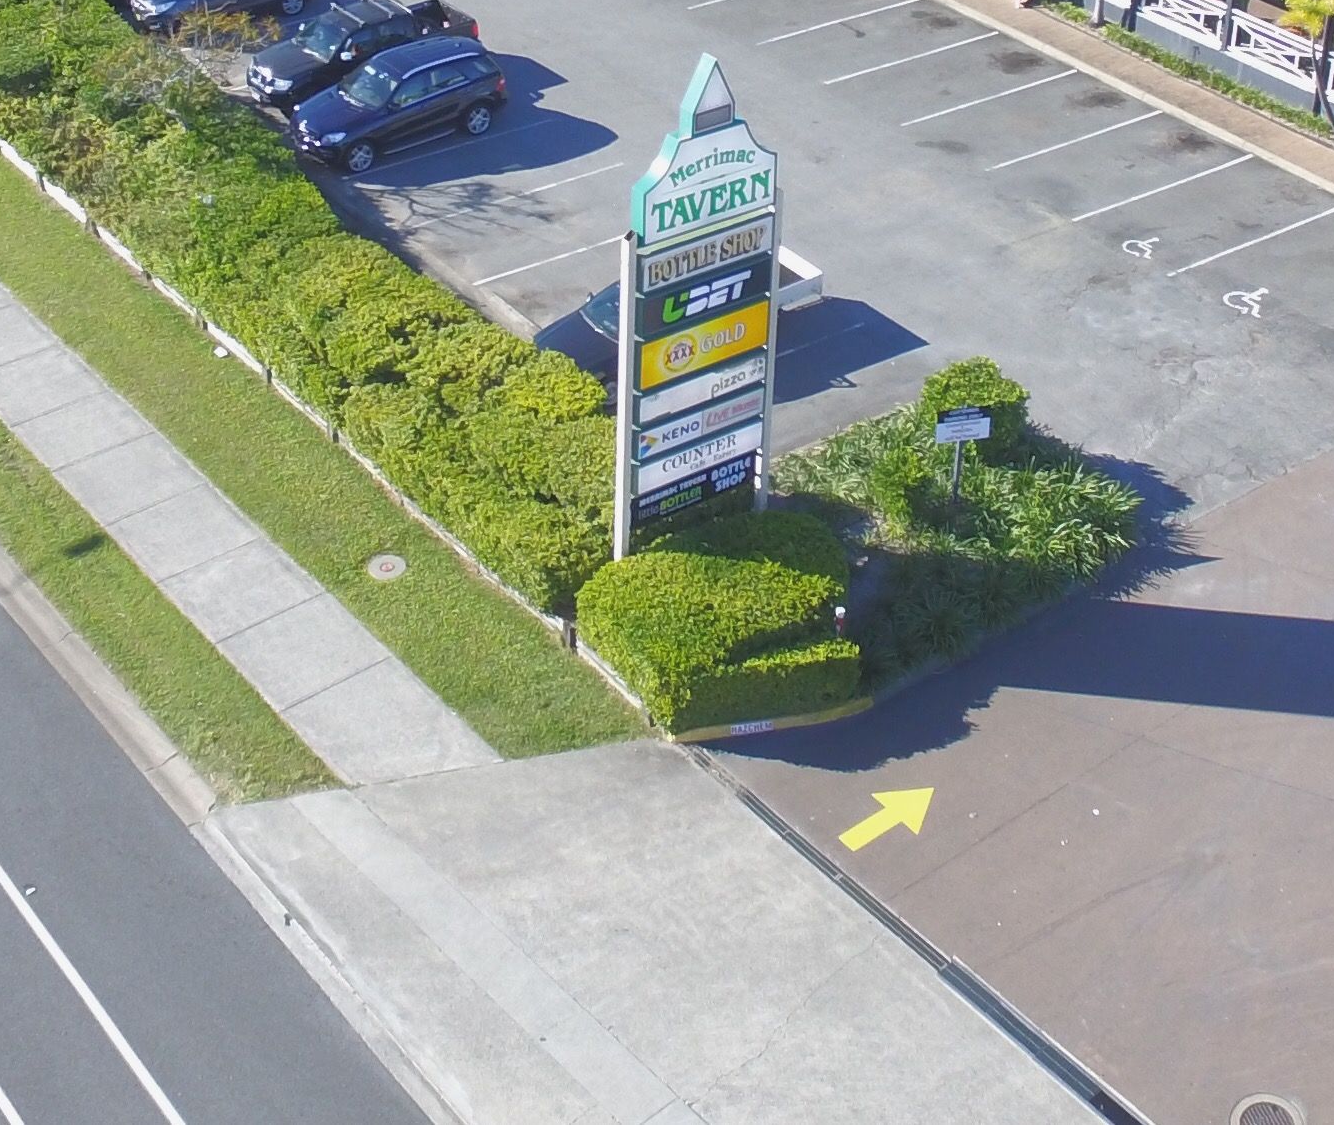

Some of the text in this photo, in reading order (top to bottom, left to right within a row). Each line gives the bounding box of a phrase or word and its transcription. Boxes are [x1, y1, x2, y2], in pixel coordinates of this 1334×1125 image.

[669, 147, 756, 188] Merrimac
[650, 168, 772, 233] TAVERN
[648, 226, 766, 286] BOTTLE SHOP
[665, 322, 747, 365] XXXX GOLD
[711, 371, 747, 399] pizza
[661, 420, 700, 443] KENO
[662, 433, 737, 473] COUNTER
[714, 471, 746, 493] SHOP
